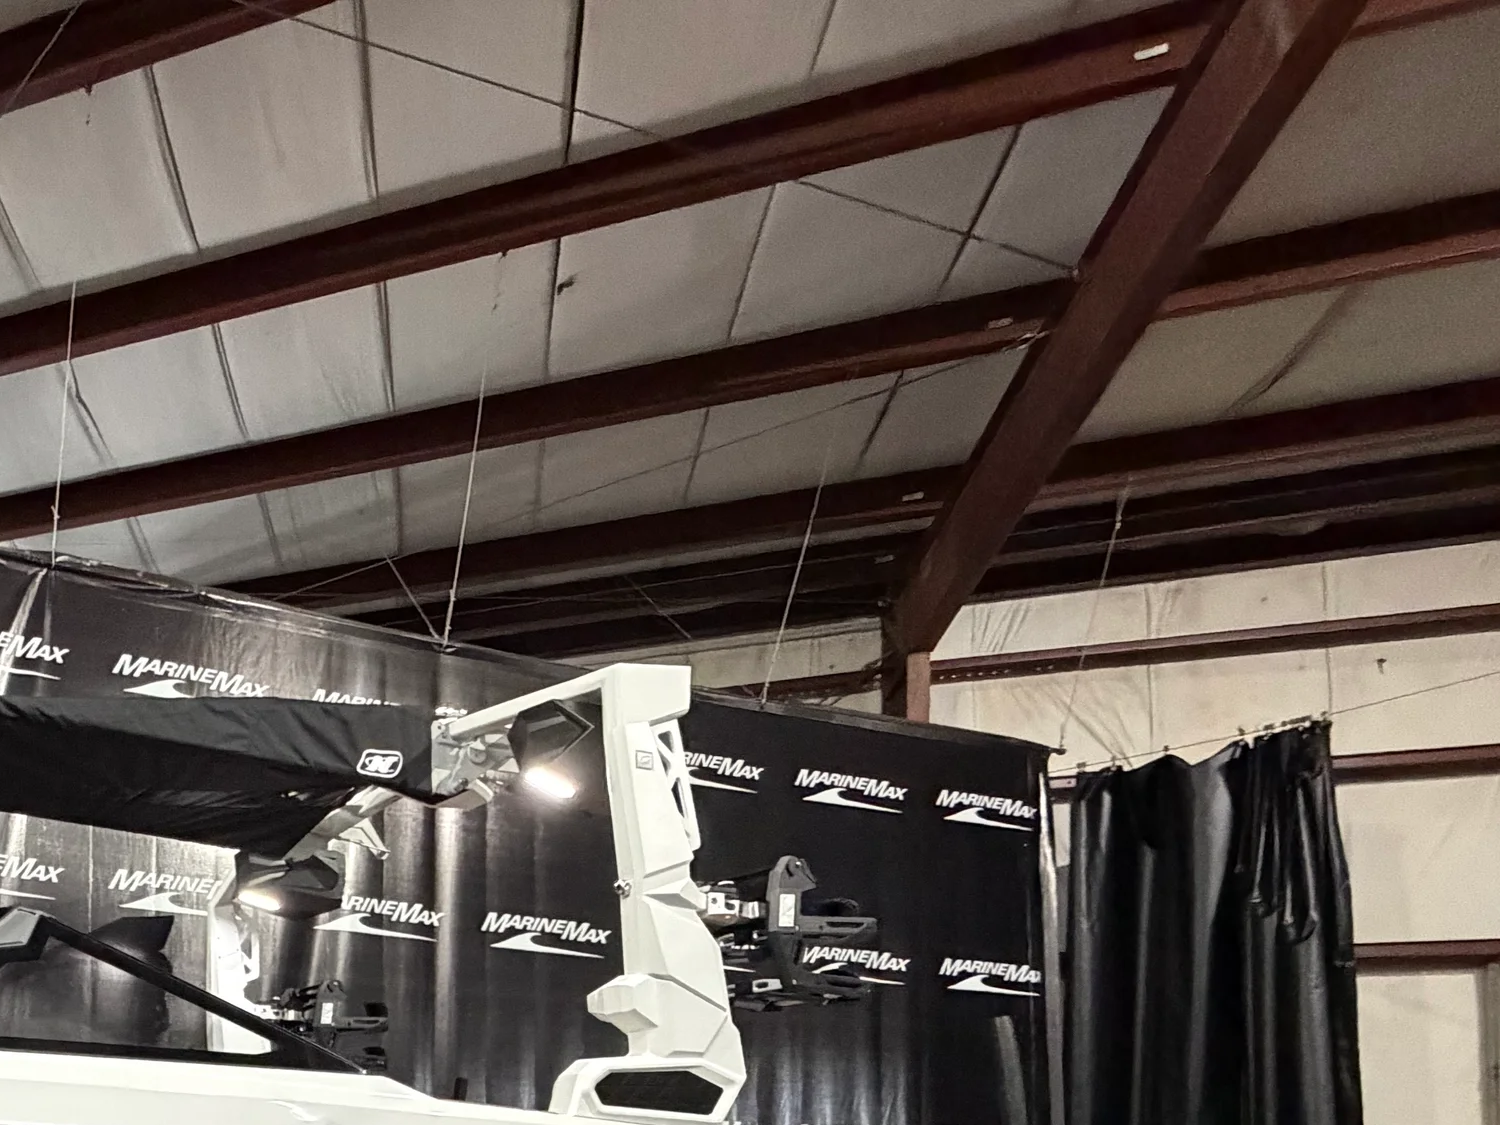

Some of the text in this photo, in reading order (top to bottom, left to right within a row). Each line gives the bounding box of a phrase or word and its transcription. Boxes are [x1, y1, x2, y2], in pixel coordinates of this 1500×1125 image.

[684, 752, 764, 780] RINEMAX
[794, 768, 908, 801] MARINEMAX
[108, 868, 223, 900] MARINE
[480, 911, 613, 945] MARINEMAX
